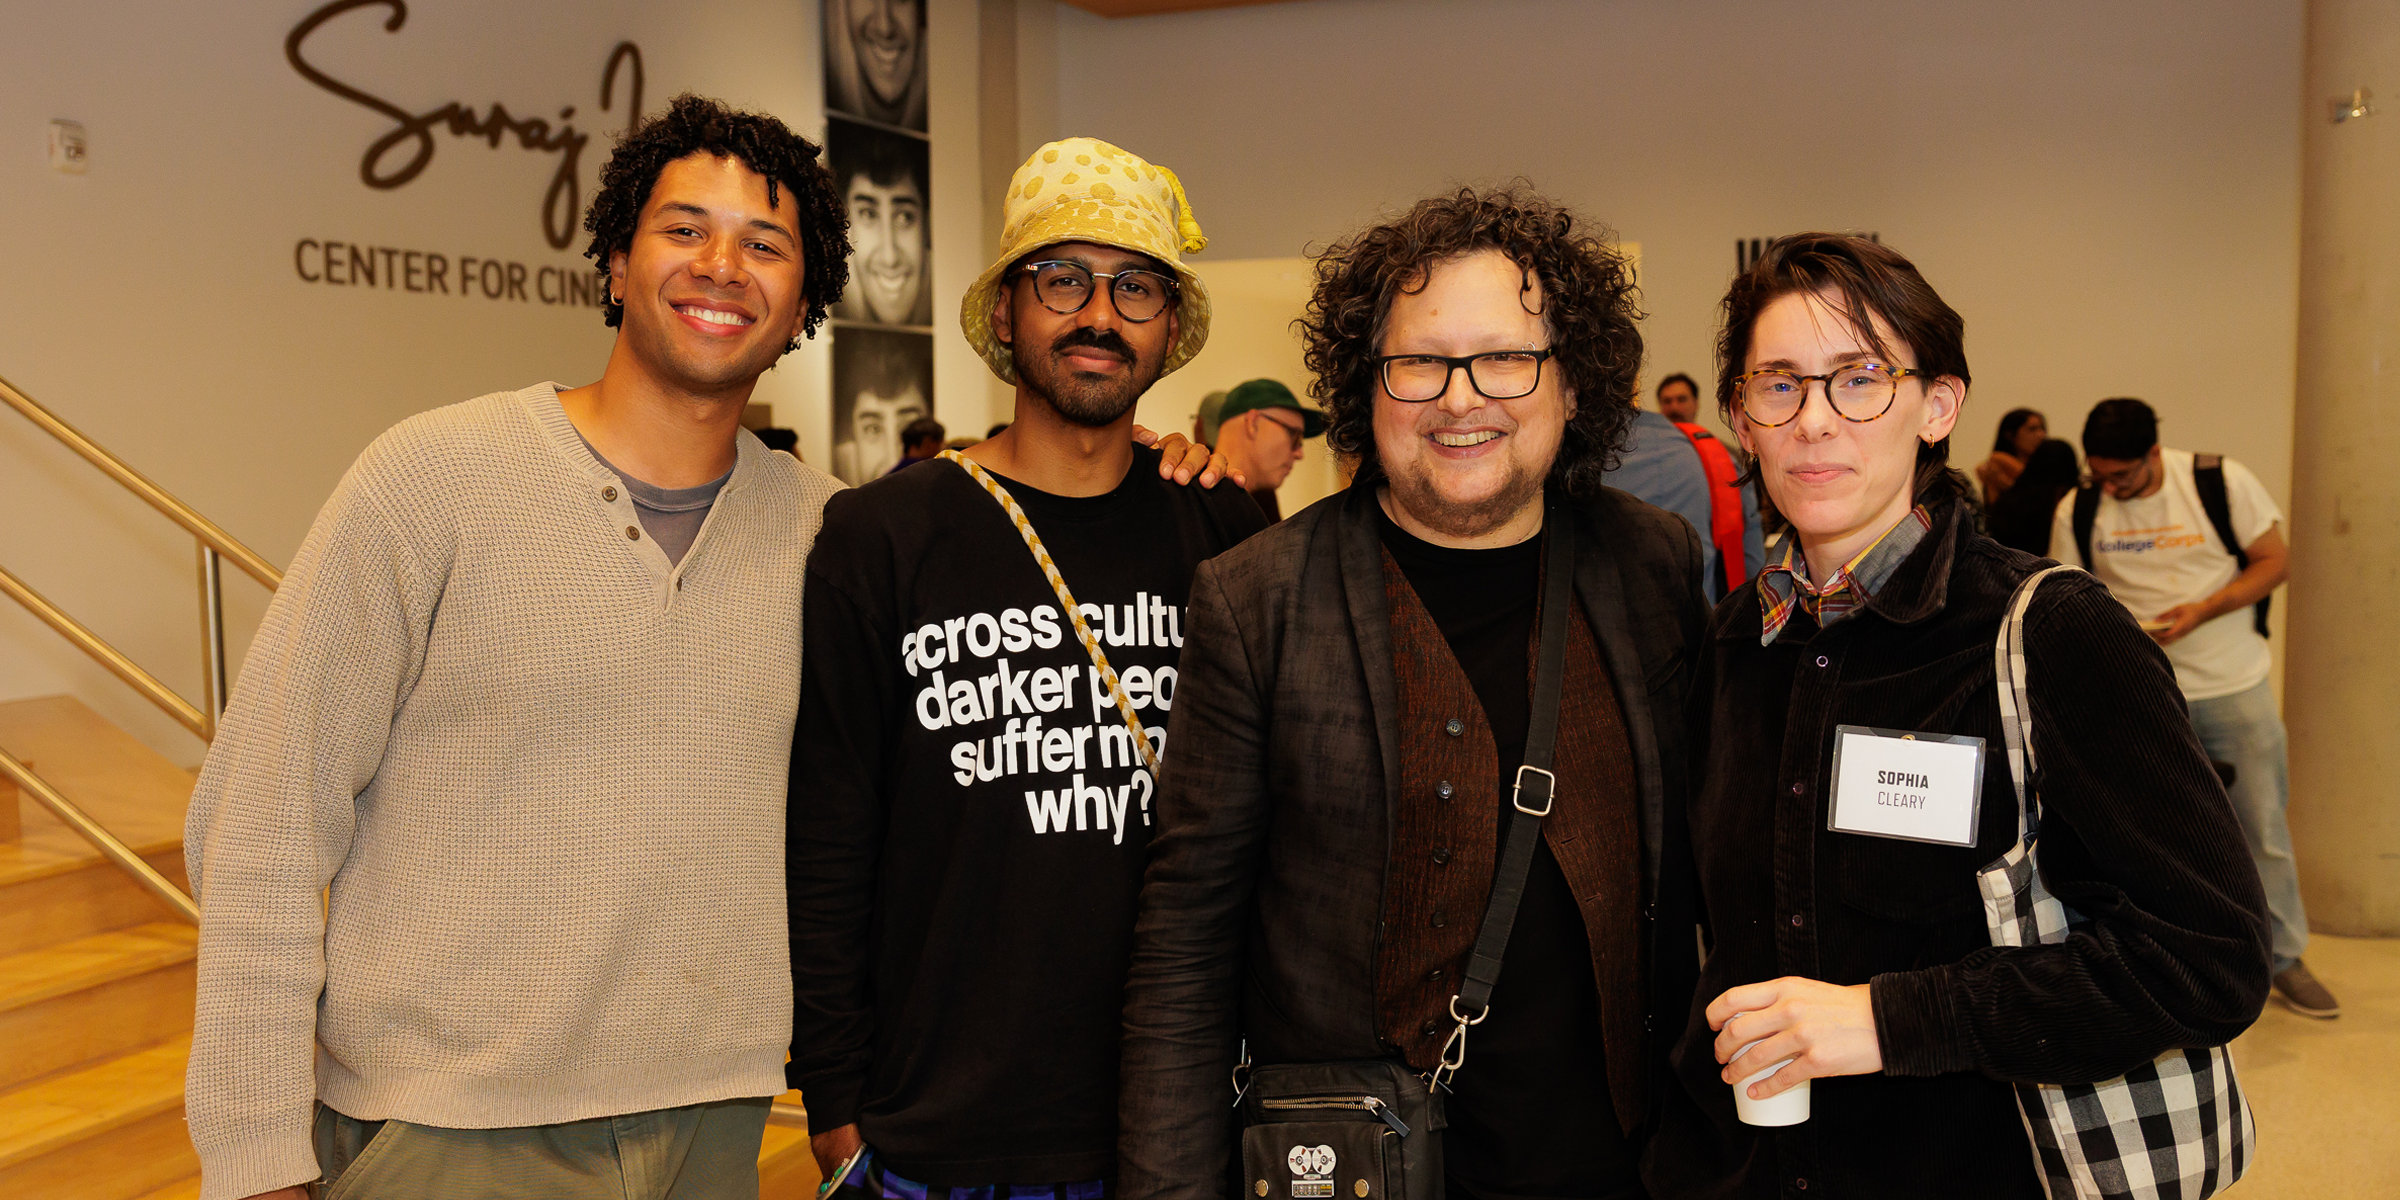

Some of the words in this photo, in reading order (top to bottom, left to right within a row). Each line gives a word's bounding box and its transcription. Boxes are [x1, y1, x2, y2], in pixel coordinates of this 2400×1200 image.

[284, 0, 589, 251] Suraj
[294, 238, 450, 296] CENTER
[459, 255, 530, 303] FOR
[901, 604, 1063, 678] across
[916, 658, 1080, 731] darker
[1089, 664, 1179, 723] peo
[950, 716, 1093, 787] suffer
[1877, 770, 1929, 789] SOPHIA
[1024, 769, 1154, 846] why?
[1877, 791, 1926, 810] CLEARY
